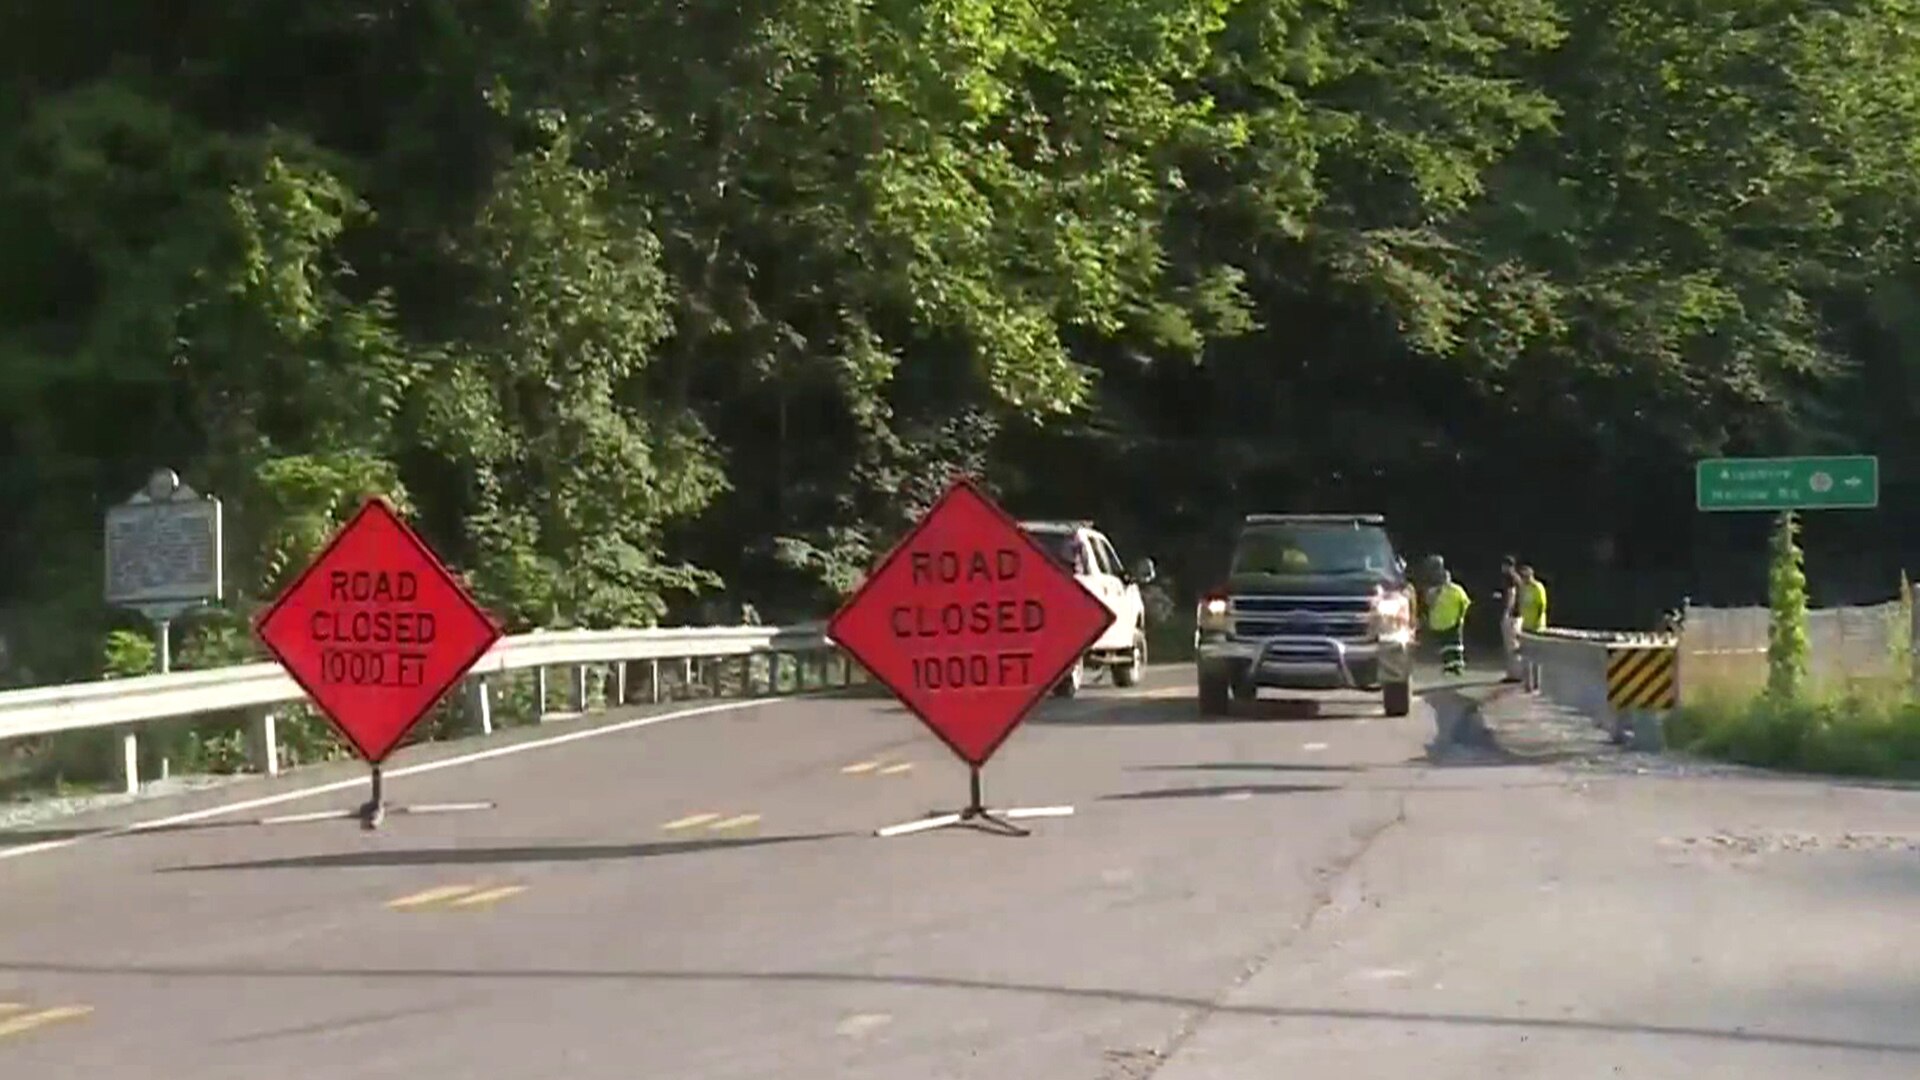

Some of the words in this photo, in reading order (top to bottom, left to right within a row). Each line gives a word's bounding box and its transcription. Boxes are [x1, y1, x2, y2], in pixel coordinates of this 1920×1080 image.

[911, 549, 1021, 585] ROAD
[330, 570, 418, 602] ROAD
[311, 610, 436, 645] CLOSED
[892, 600, 1045, 638] CLOSED
[321, 651, 385, 685] 1000
[398, 653, 427, 685] FT
[912, 654, 988, 689] 1000
[998, 653, 1033, 686] FT
